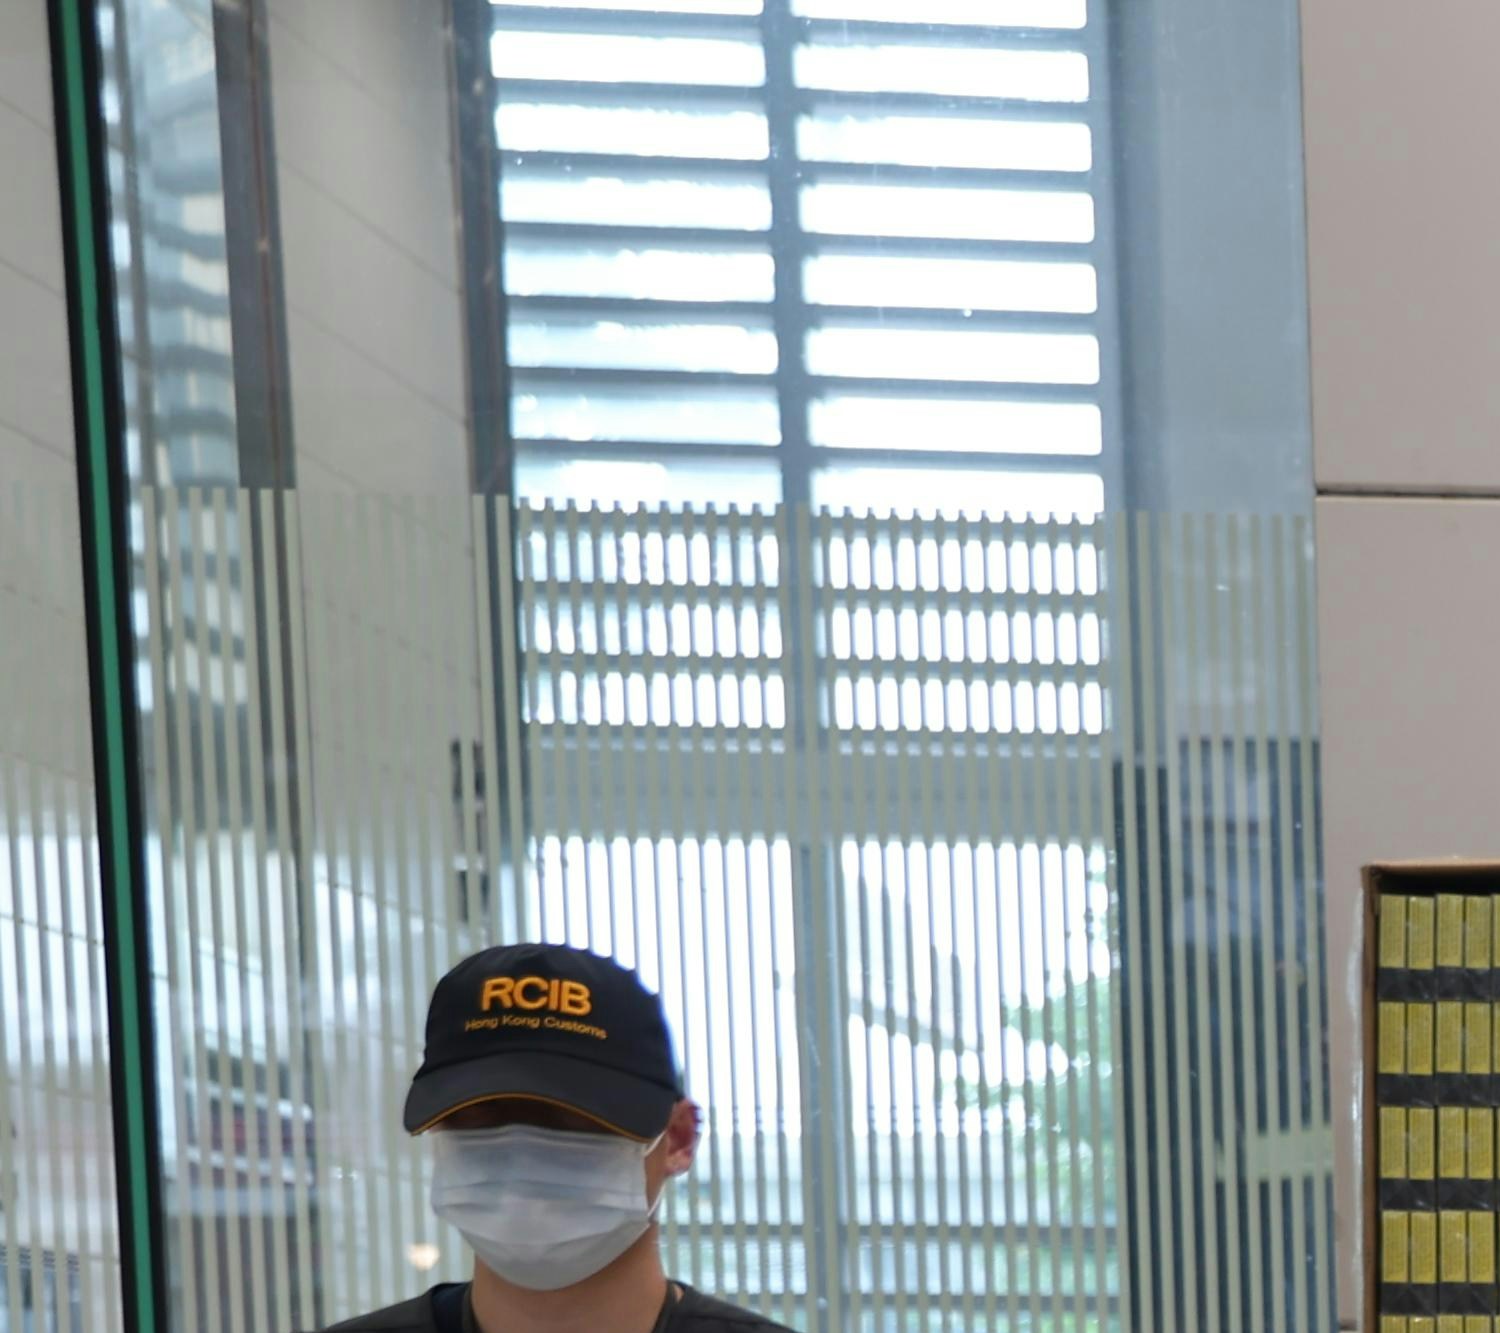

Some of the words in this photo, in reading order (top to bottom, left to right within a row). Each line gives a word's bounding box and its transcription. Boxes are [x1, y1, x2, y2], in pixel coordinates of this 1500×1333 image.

[481, 975, 593, 1017] RCIB
[464, 1016, 499, 1032] Hong
[502, 1015, 541, 1029] Kong
[544, 1015, 609, 1040] Customs
